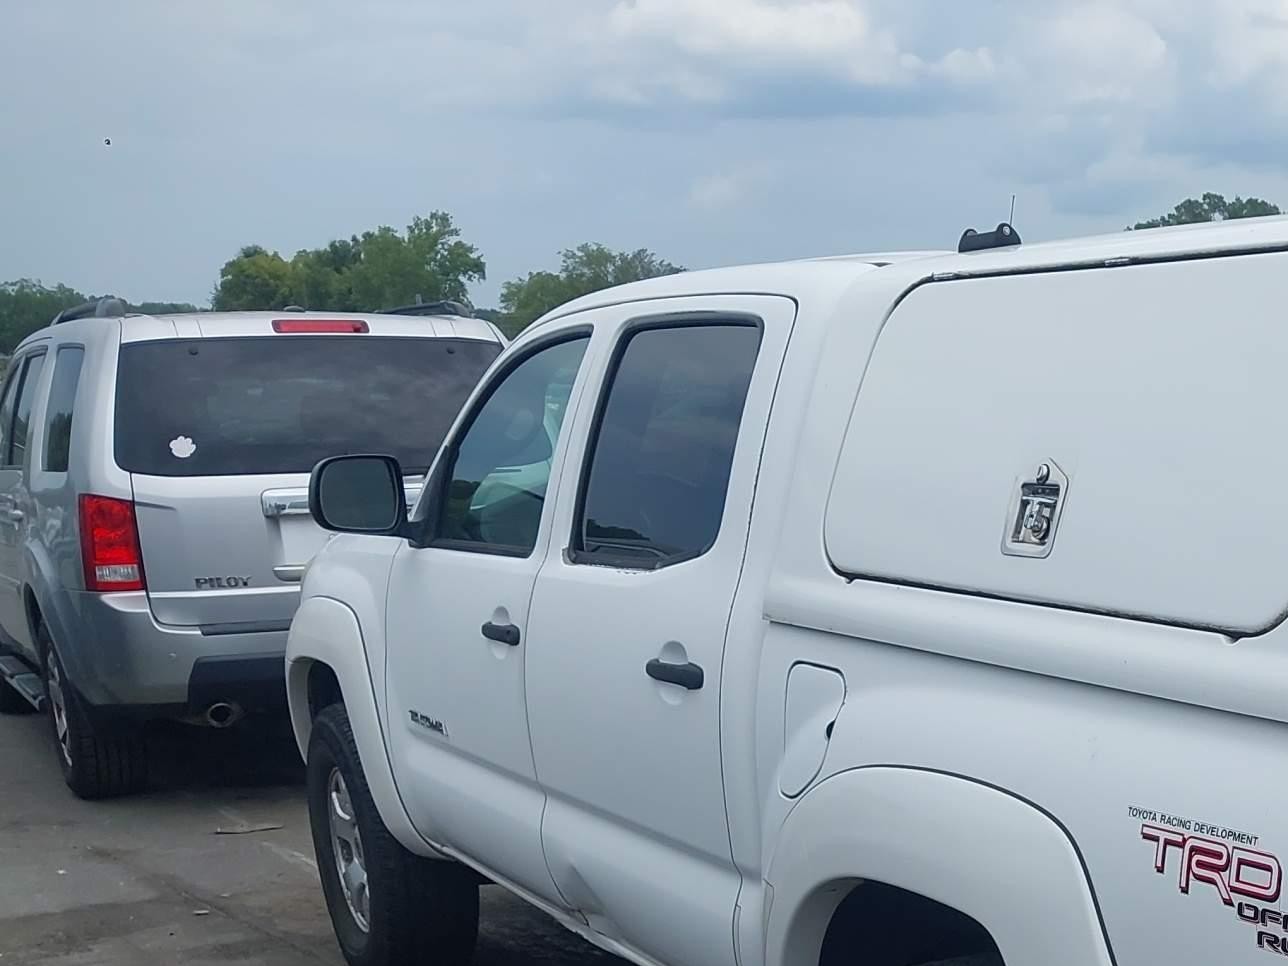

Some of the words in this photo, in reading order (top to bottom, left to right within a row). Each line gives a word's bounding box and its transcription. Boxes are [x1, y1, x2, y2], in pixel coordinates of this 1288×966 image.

[1128, 806, 1157, 823] TOYOTA
[1160, 814, 1192, 831] RACING
[1193, 822, 1259, 847] DEVELOPMENT
[1141, 824, 1283, 907] TRD
